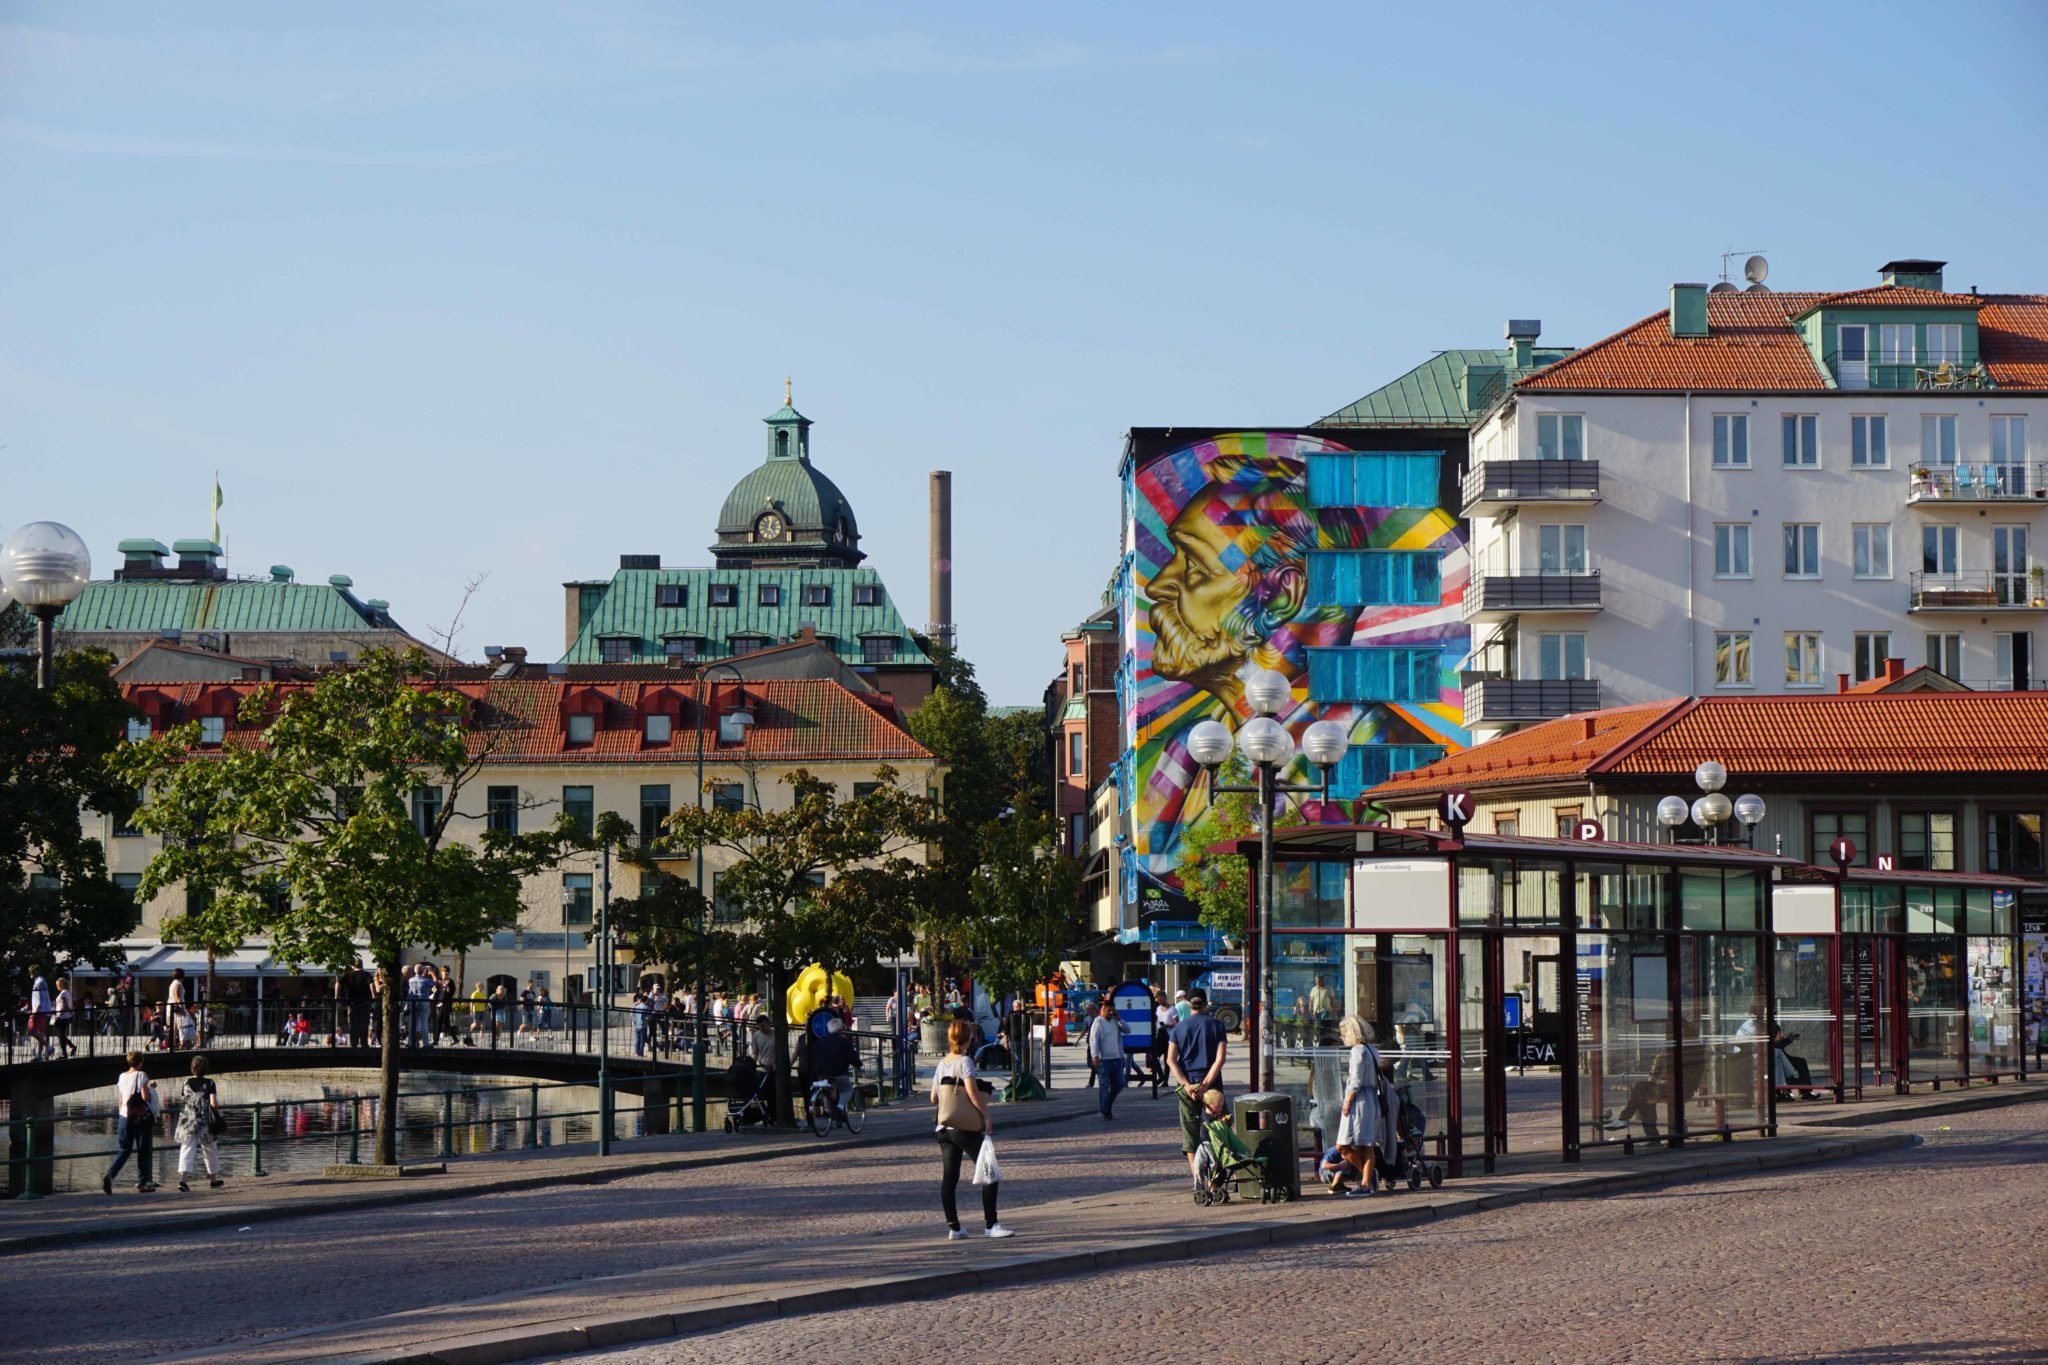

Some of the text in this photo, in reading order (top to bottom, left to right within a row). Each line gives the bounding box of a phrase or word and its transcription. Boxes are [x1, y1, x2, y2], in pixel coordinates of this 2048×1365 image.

[1448, 794, 1467, 820] K
[1582, 824, 1597, 840] P
[1840, 842, 1846, 860] I
[1358, 861, 1364, 870] 7
[1878, 857, 1892, 870] N
[1523, 1043, 1556, 1061] EVA
